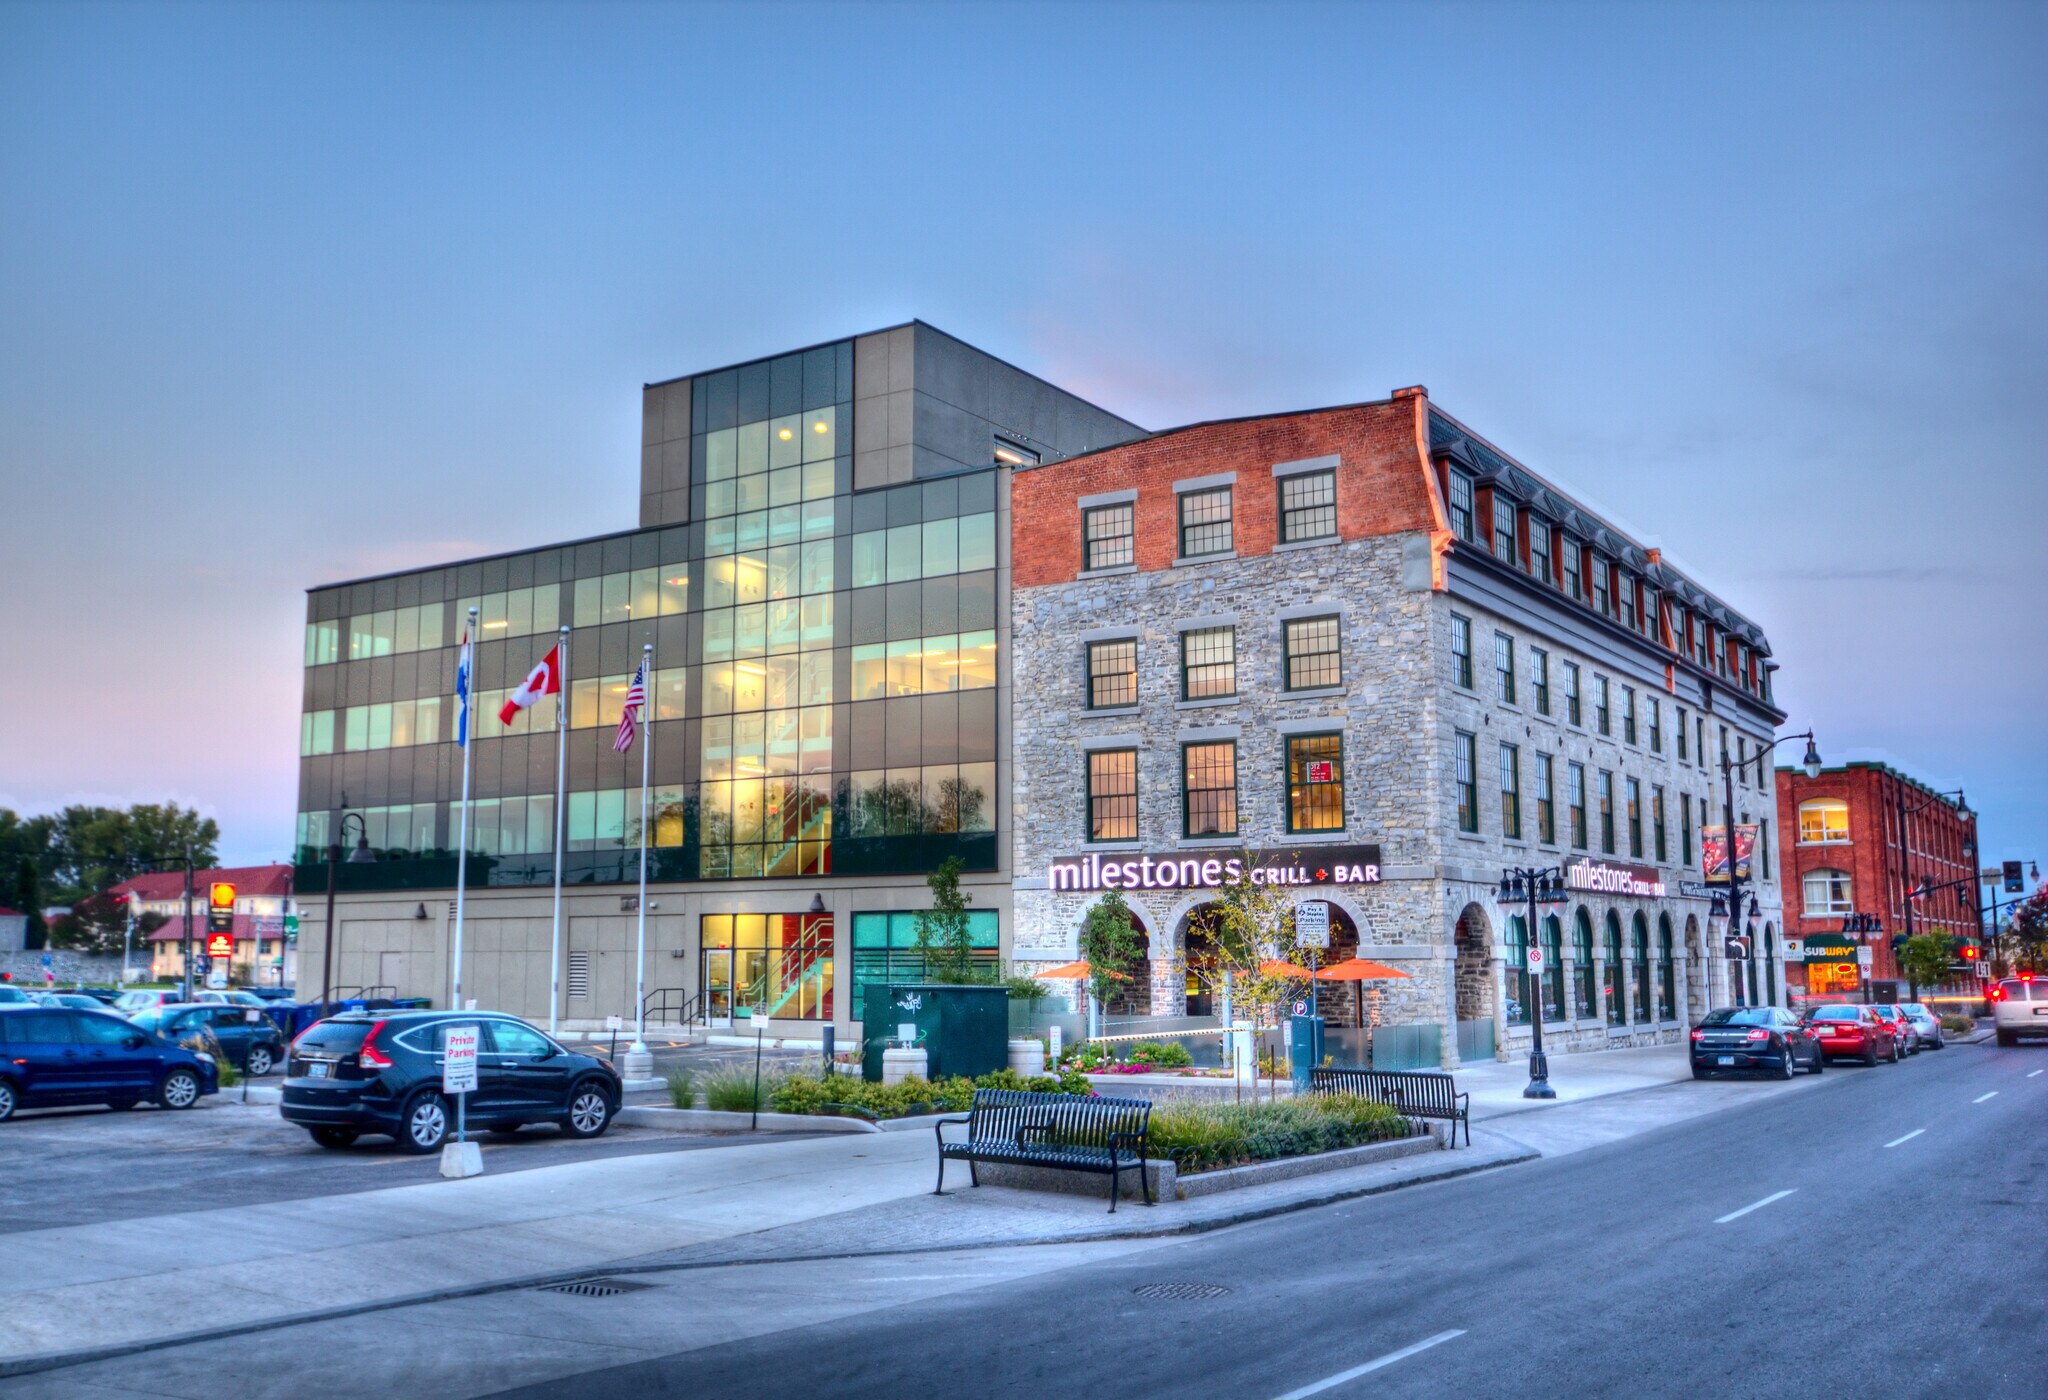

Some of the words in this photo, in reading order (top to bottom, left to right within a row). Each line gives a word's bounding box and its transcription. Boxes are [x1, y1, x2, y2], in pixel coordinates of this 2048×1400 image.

[1048, 854, 1240, 889] milestones
[1251, 867, 1312, 886] GRILL
[1334, 865, 1380, 882] BAR
[1571, 857, 1633, 893] milestones
[1634, 880, 1651, 896] GRILL
[1654, 883, 1666, 897] BAR
[1804, 946, 1855, 957] SUBWAY
[450, 1036, 475, 1045] Private
[448, 1049, 475, 1058] Parking
